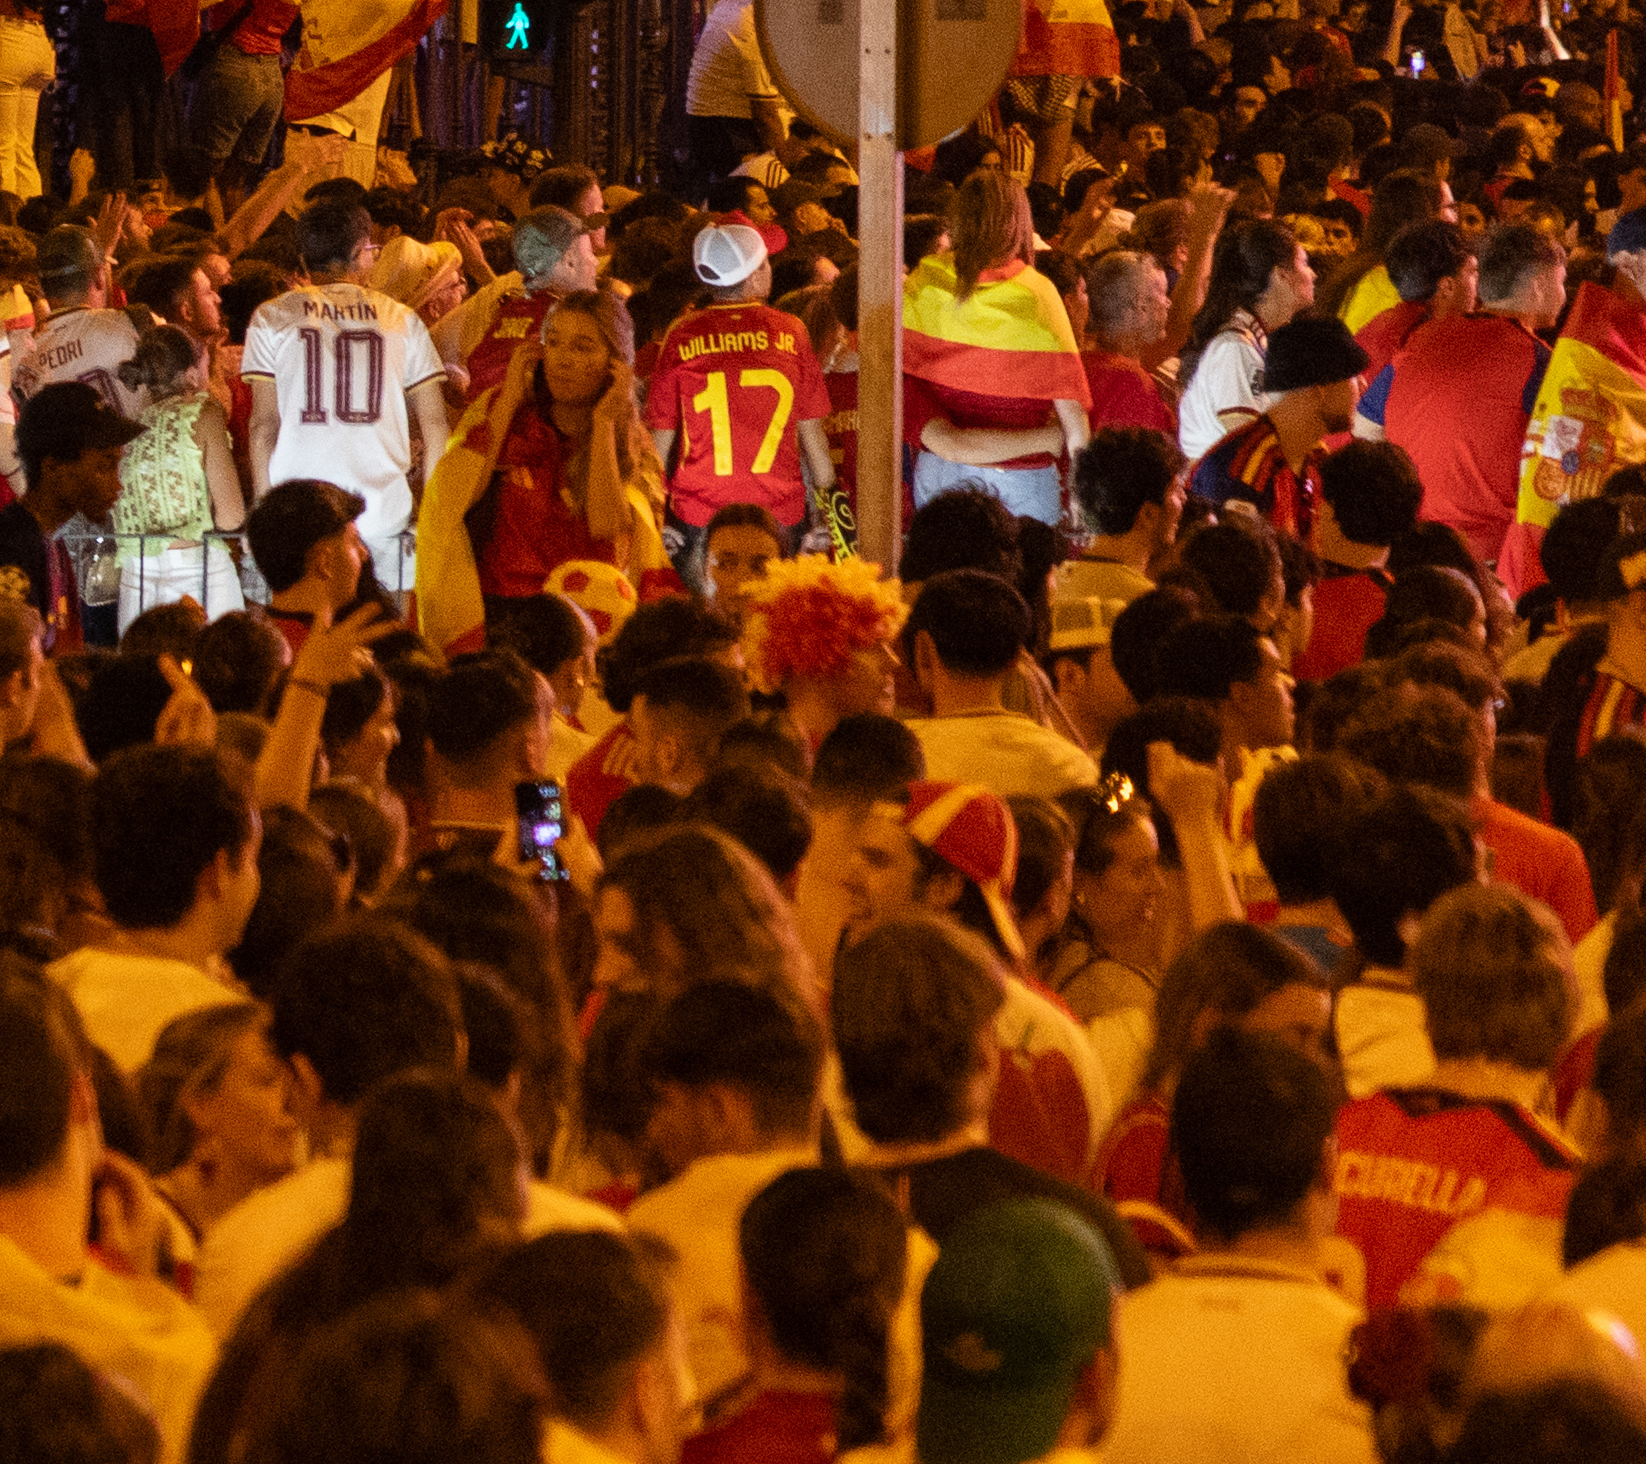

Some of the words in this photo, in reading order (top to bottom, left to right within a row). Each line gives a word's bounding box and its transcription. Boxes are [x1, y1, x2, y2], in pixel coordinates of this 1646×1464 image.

[38, 339, 84, 368] PEDRI
[299, 326, 385, 425] 10
[678, 330, 770, 361] WILLIAMS
[693, 368, 795, 476] 17
